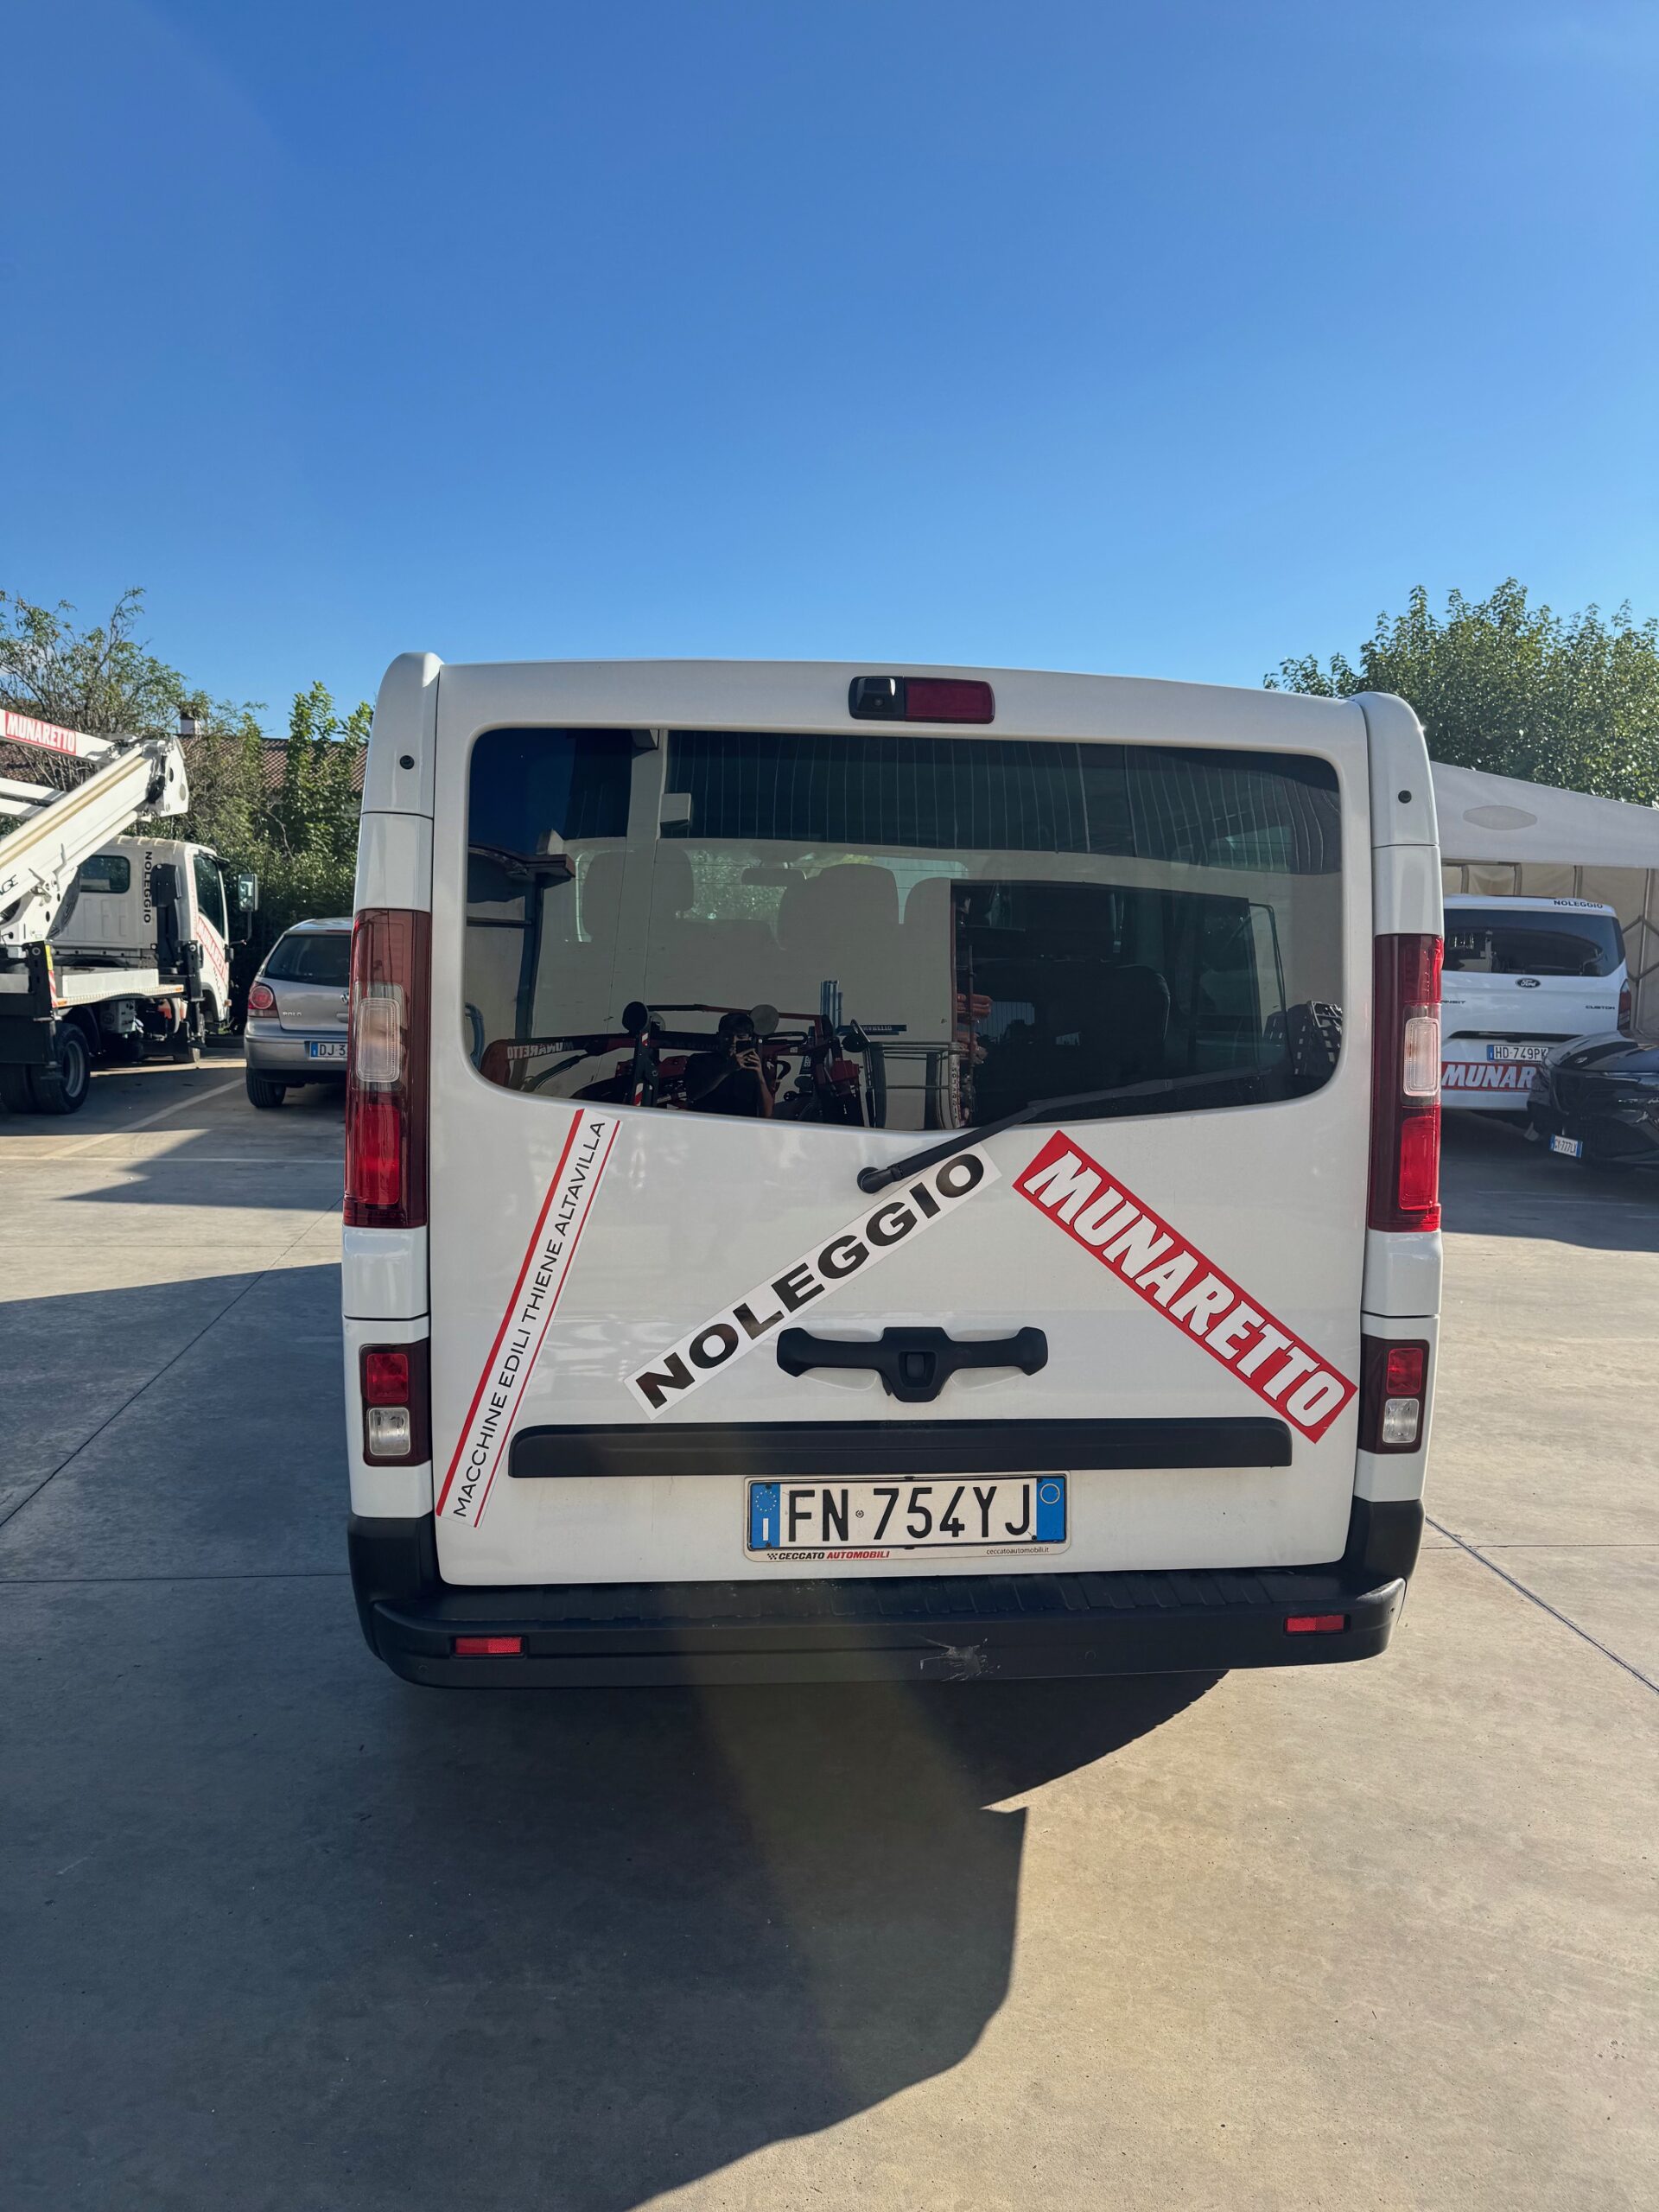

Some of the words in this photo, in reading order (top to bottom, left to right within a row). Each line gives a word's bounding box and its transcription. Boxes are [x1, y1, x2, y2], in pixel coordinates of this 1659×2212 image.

[7, 713, 75, 753] MUNARETTO
[143, 851, 153, 924] NOLEGGIO
[1554, 900, 1603, 909] NOLEGGIO
[320, 1044, 334, 1056] DJ
[339, 1044, 346, 1056] 3
[1495, 1046, 1509, 1058] HD
[1441, 1064, 1536, 1089] MUNAR
[634, 1153, 985, 1409] NOLEGGIO
[1023, 1149, 1349, 1428] MUNARETTO
[453, 1391, 508, 1517] MACCHINE
[499, 1328, 531, 1389] EDILI
[522, 1238, 563, 1324] THIENE
[554, 1122, 606, 1236] ALTAVILLA
[788, 1488, 849, 1542] FN
[873, 1484, 1030, 1541] 754YJ
[827, 1550, 890, 1559] AUTOMOBILI
[986, 1546, 1049, 1555] ceccatoautomobili.it
